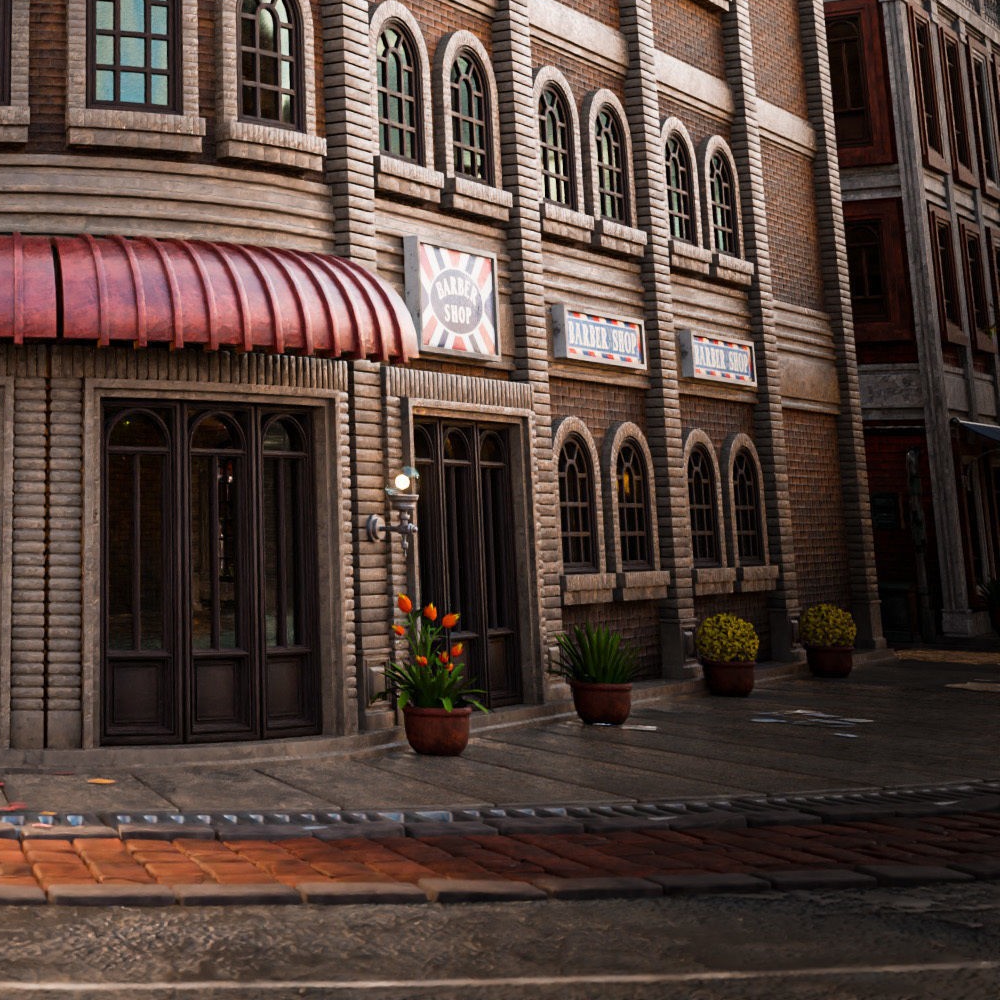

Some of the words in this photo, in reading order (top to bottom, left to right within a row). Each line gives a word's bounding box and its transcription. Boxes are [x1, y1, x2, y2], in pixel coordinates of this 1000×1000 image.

[435, 276, 478, 306] BARBER
[444, 303, 472, 325] SHOP
[568, 321, 608, 349] BARBER
[612, 328, 637, 354] SHOP
[694, 344, 726, 370] BARBER
[728, 350, 748, 373] SHOP
